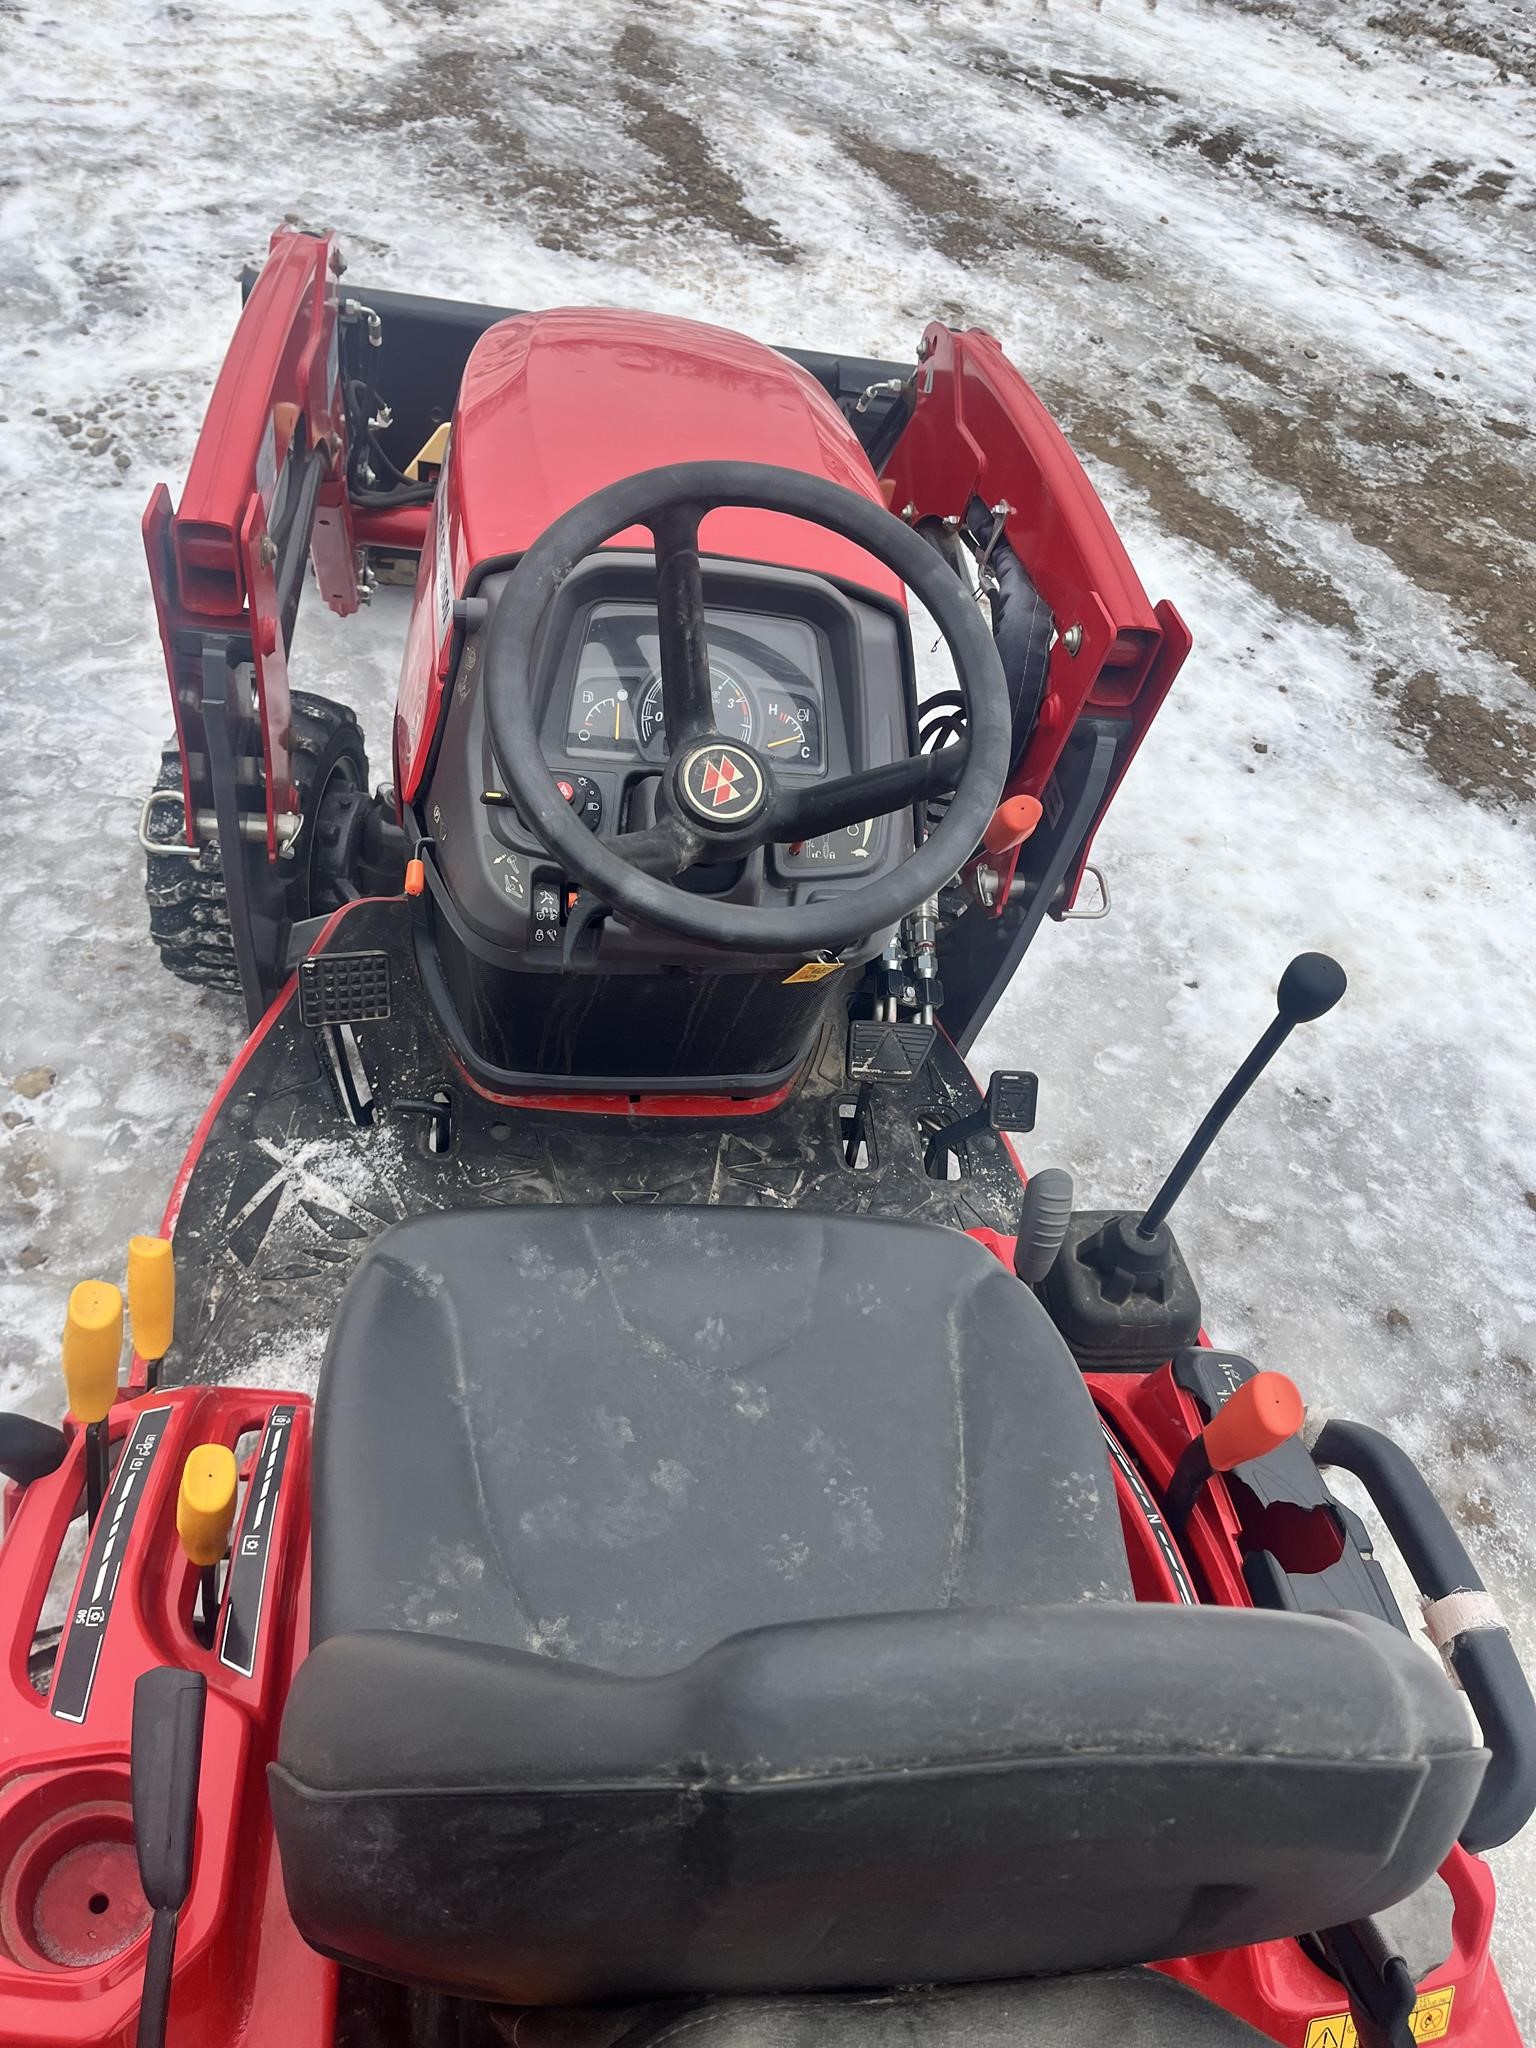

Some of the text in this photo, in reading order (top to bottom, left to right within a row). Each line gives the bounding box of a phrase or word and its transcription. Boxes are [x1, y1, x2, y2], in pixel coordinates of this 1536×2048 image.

[727, 698, 735, 708] 3
[769, 703, 778, 715] H
[655, 711, 664, 722] 0
[801, 746, 810, 758] C
[1147, 1514, 1162, 1523] N
[75, 1609, 88, 1624] 540
